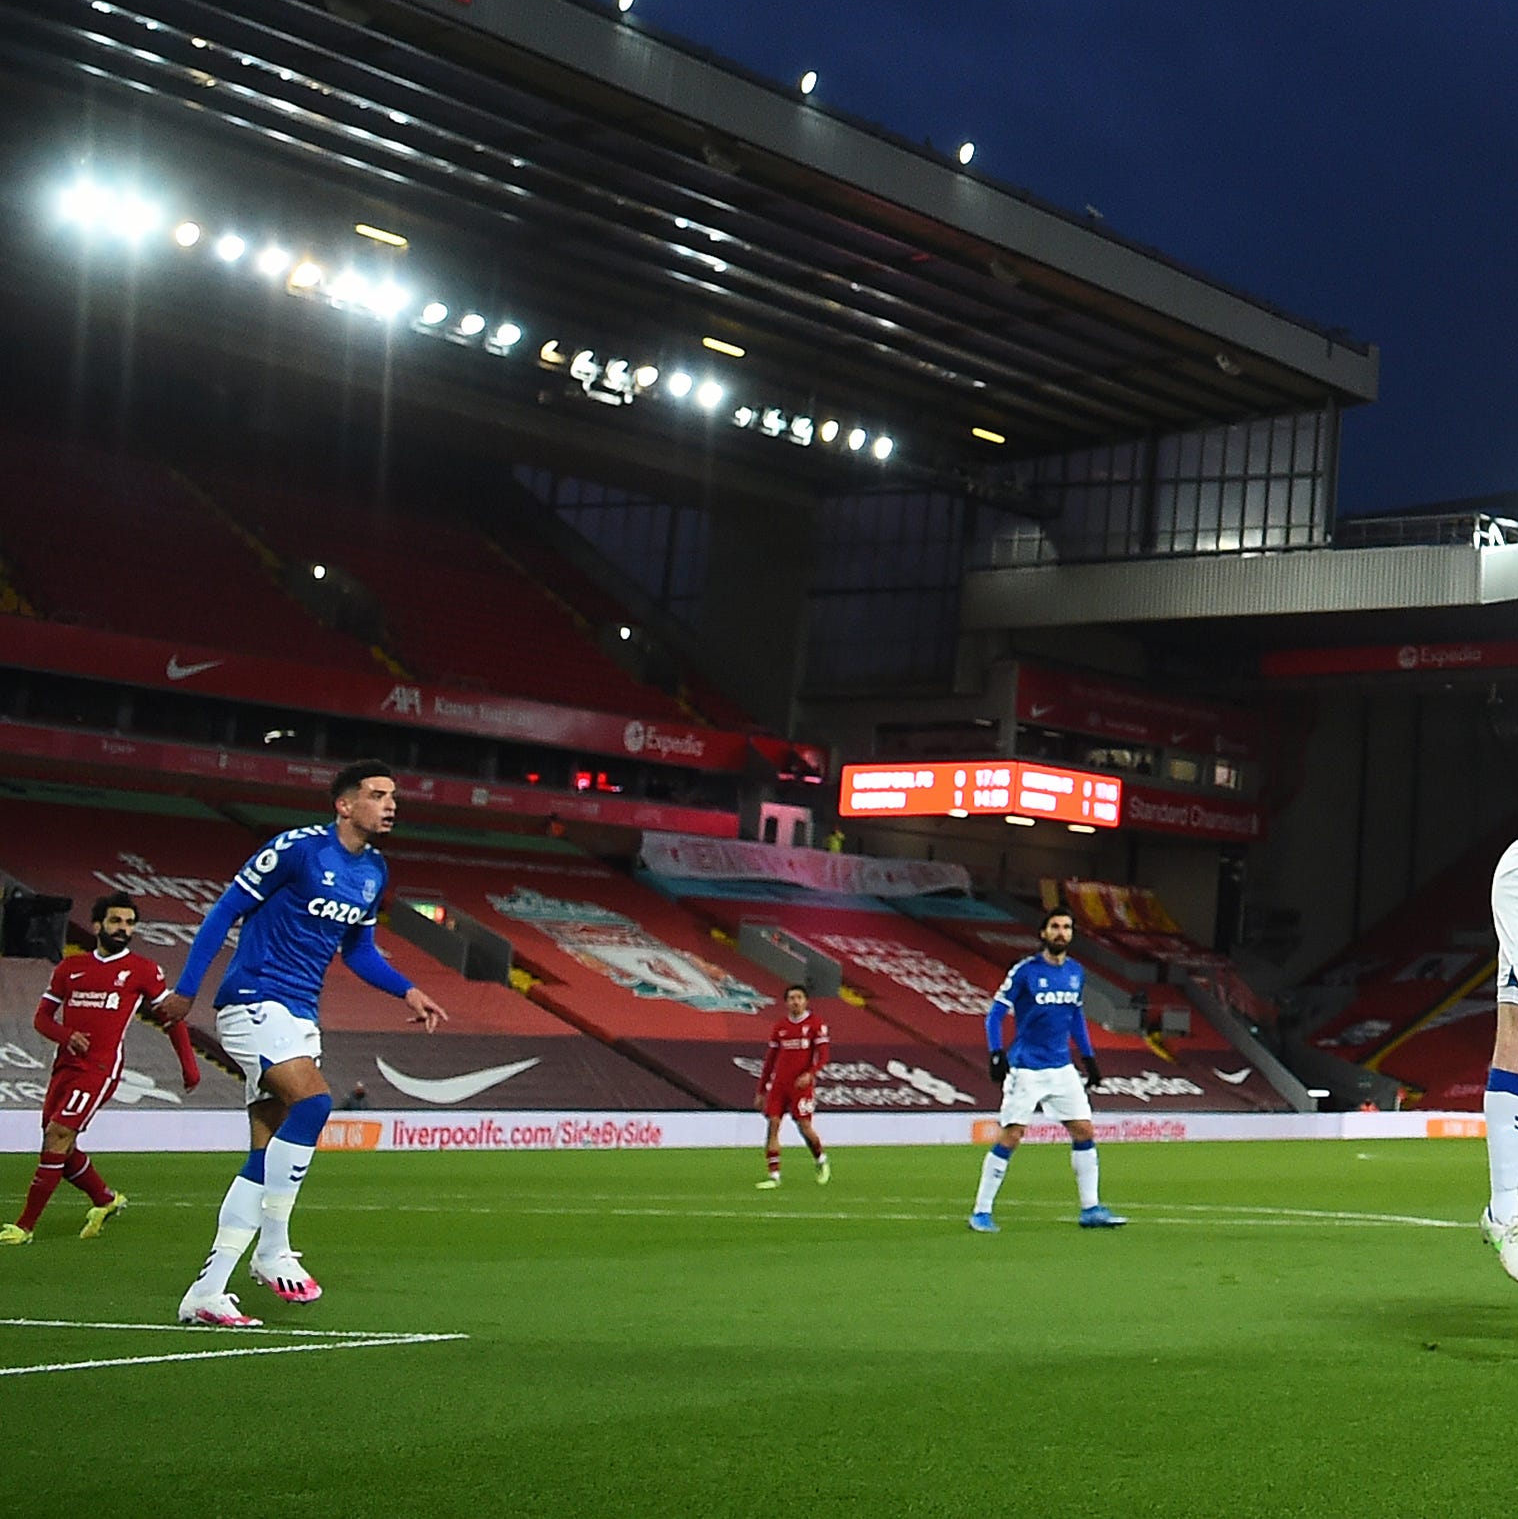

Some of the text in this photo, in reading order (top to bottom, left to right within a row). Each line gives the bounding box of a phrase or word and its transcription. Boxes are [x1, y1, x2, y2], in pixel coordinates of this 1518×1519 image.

[1421, 646, 1483, 668] Expedia
[955, 791, 963, 807] 1
[1129, 795, 1190, 827] Standard
[68, 998, 106, 1009] Chartered
[72, 990, 108, 1002] Standard
[66, 1089, 91, 1114] 11
[392, 1119, 663, 1151] liverpoolfc.com/SideBySide
